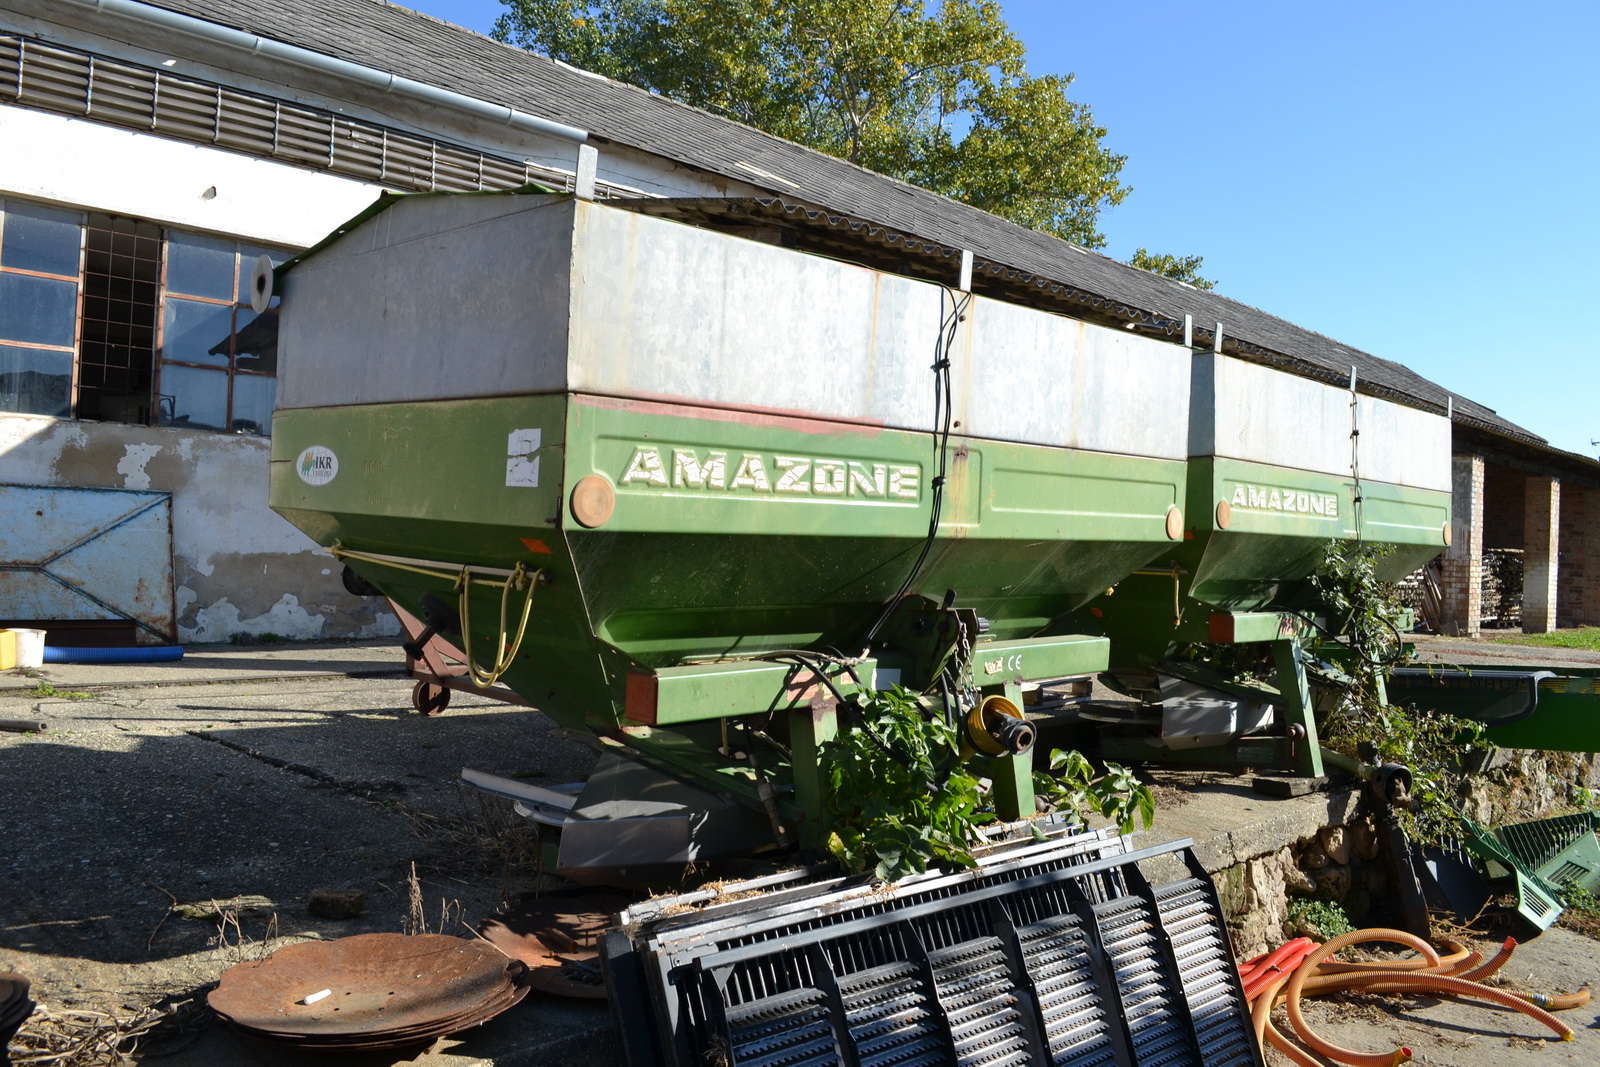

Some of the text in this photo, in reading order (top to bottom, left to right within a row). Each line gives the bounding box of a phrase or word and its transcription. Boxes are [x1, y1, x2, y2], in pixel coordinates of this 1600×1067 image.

[315, 456, 332, 469] IKR
[618, 446, 920, 498] AMAZONE
[1231, 483, 1338, 516] AMAZONE
[1008, 655, 1022, 671] CE
